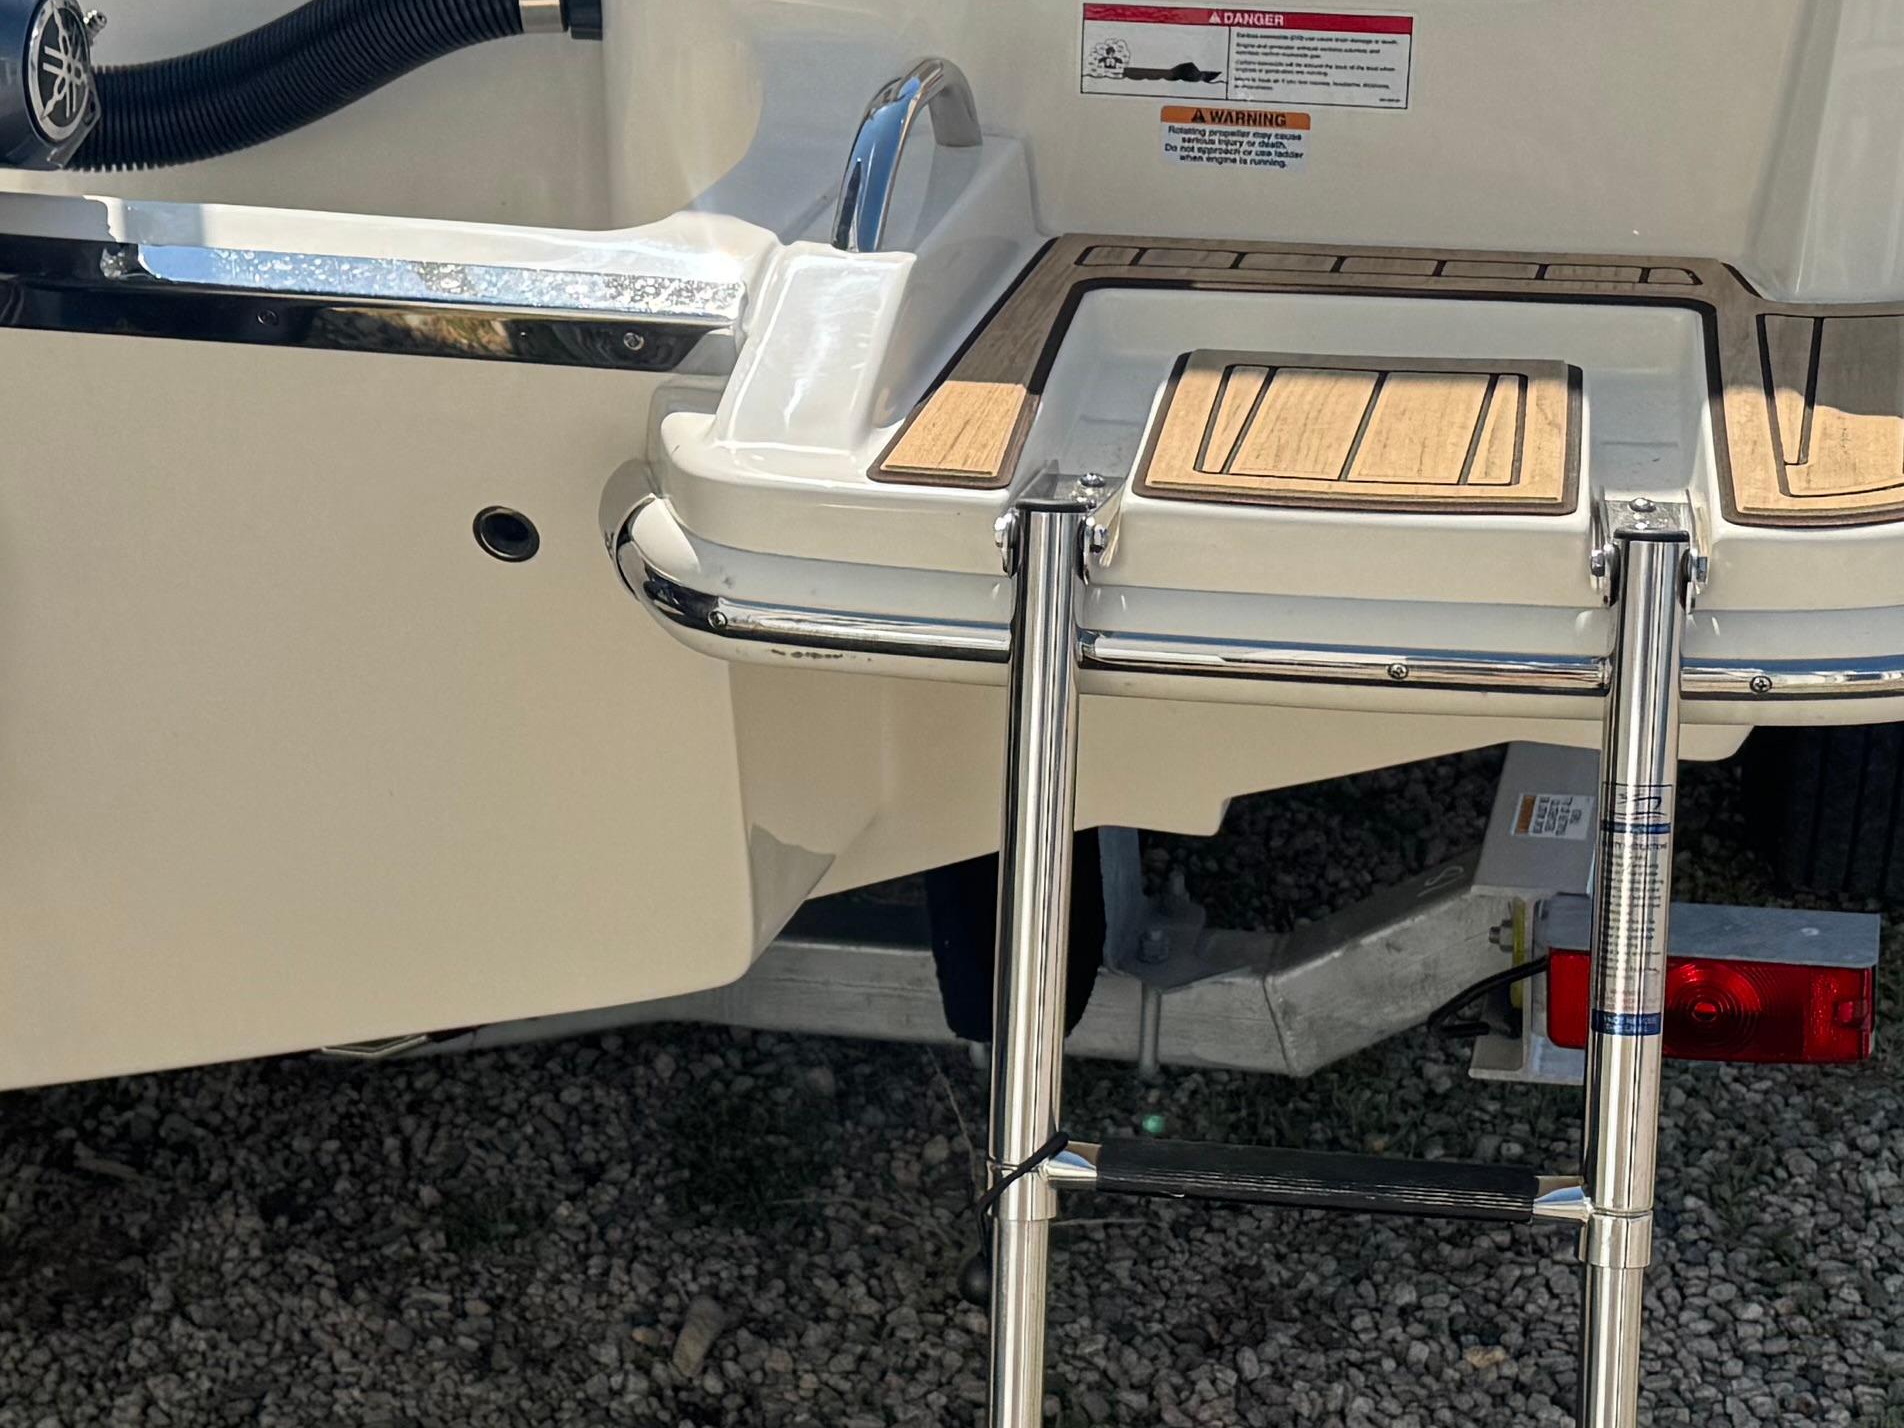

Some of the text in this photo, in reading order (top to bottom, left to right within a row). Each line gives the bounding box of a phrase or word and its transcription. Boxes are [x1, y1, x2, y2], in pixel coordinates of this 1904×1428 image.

[1223, 11, 1284, 27] DANGER
[1210, 109, 1287, 127] WARNING
[1180, 144, 1195, 153] not
